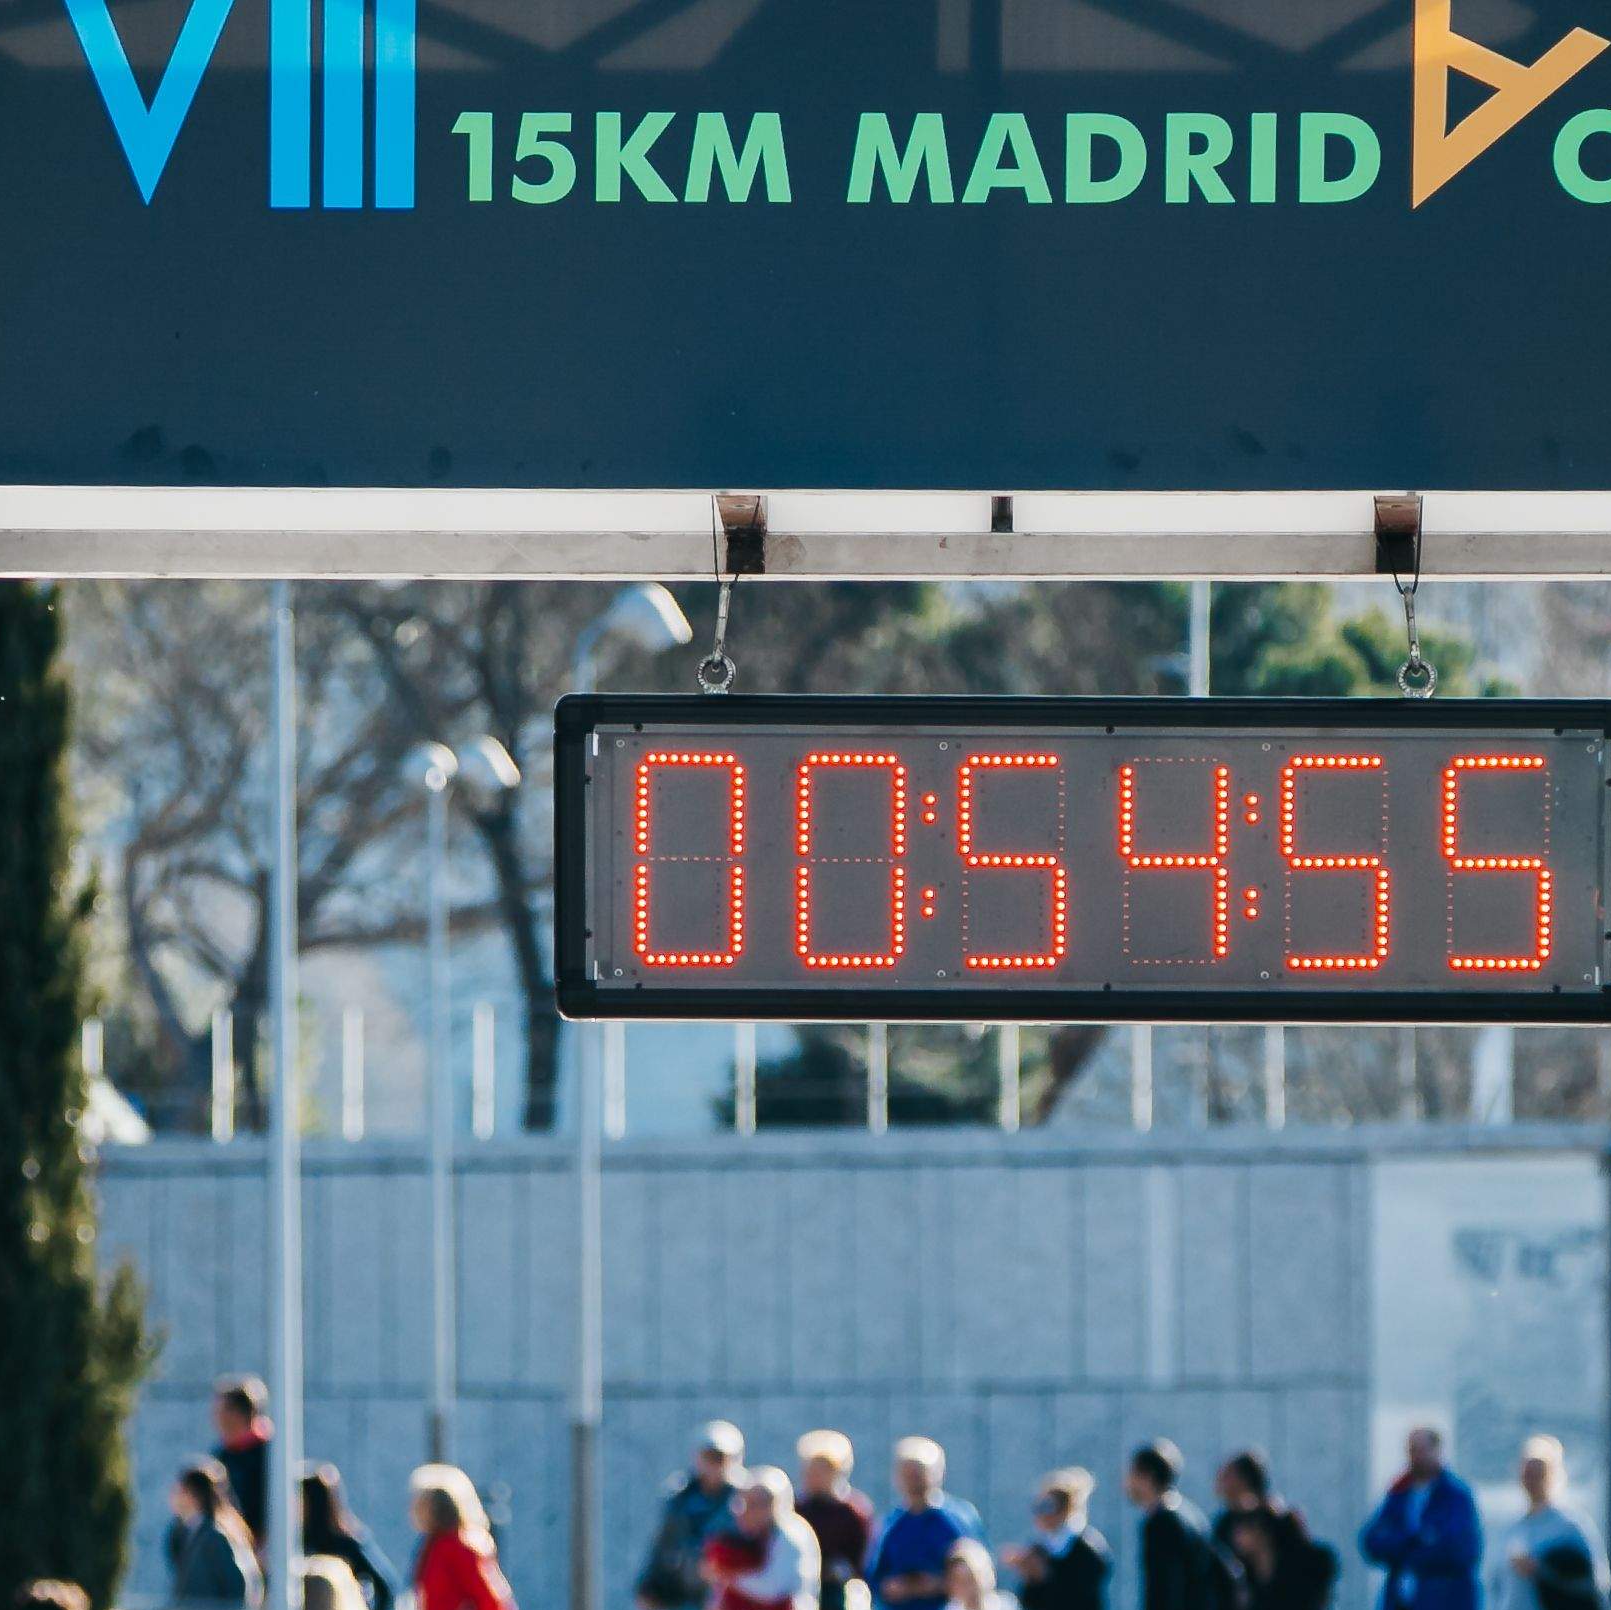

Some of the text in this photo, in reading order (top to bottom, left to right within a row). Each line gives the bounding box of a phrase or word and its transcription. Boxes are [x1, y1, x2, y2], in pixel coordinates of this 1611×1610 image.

[64, 0, 417, 209] VIII
[451, 111, 792, 205] 15KM
[633, 750, 1553, 973] 00:54:55
